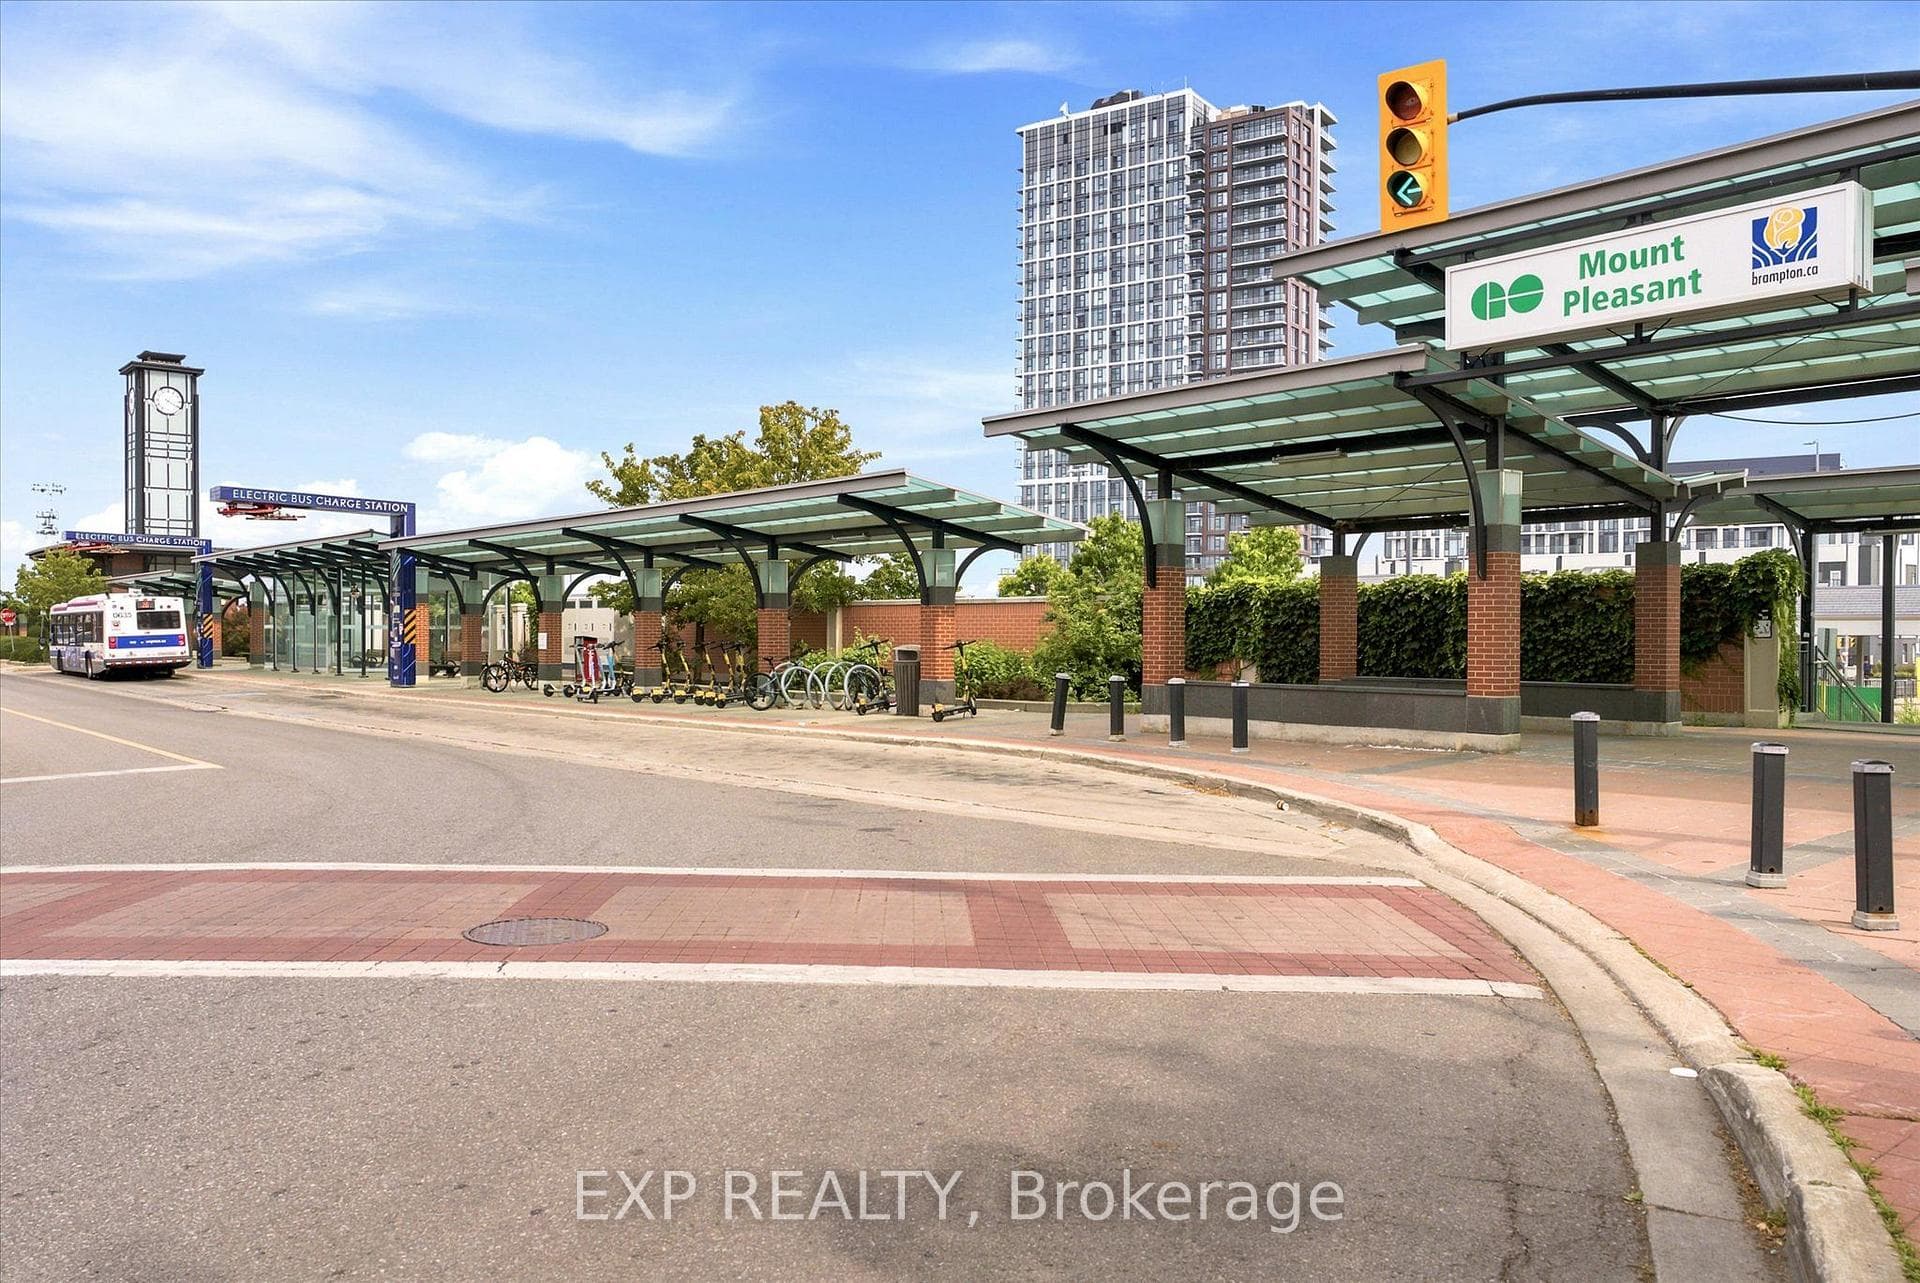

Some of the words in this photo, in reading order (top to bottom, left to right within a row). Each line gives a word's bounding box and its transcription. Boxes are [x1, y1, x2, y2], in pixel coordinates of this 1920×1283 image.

[1579, 235, 1685, 281] Mount
[1751, 265, 1819, 286] brampton.ca
[1563, 268, 1702, 317] Pleasant
[232, 488, 287, 502] ELECTRIC
[291, 494, 312, 505] BUS
[315, 496, 361, 509] CHARGE
[364, 500, 408, 513] STATION
[75, 532, 116, 542] ELECTRIC
[136, 536, 170, 545] CHARGE
[172, 538, 206, 546] STATION
